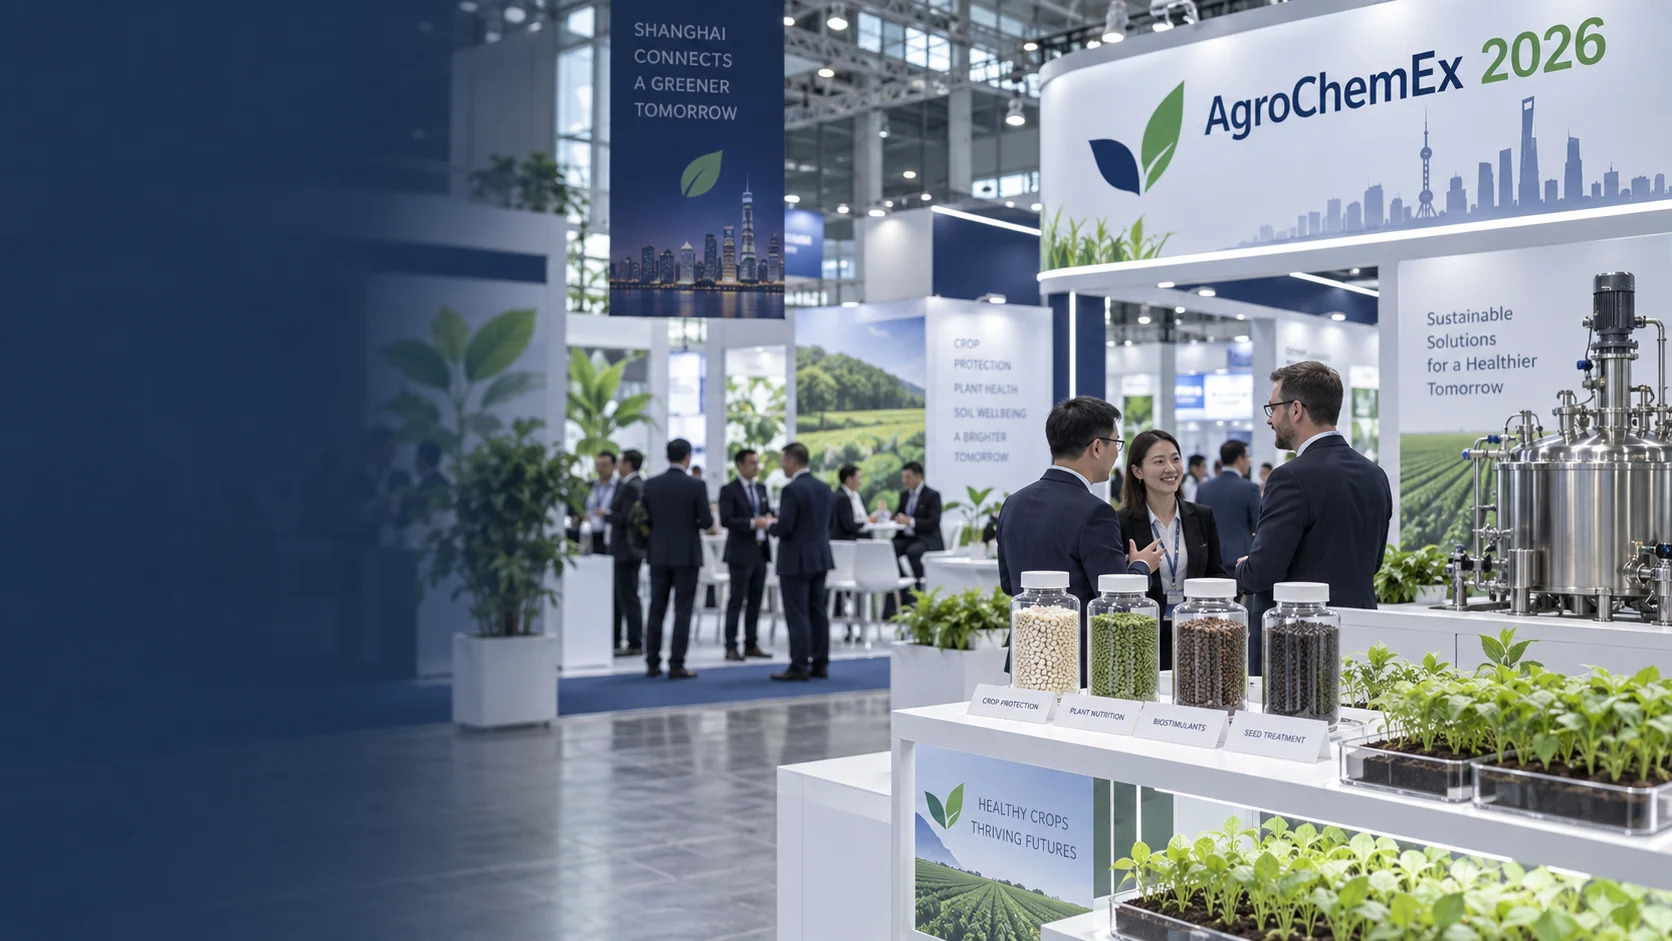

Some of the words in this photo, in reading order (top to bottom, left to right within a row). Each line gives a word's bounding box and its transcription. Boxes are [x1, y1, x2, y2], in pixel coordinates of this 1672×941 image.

[634, 22, 726, 41] SHANGHAI
[634, 48, 733, 68] CONNECTS
[634, 75, 646, 91] A
[651, 76, 730, 94] GREENER
[1204, 50, 1464, 141] AgroChemEx
[1481, 16, 1607, 85] 2026
[634, 102, 738, 121] TOMORROW
[1427, 306, 1513, 326] Sustainable
[954, 338, 980, 349] CROP
[1427, 333, 1497, 350] Solutions
[954, 358, 1012, 371] PROTECTION
[1427, 358, 1448, 373] for
[1453, 361, 1461, 372] a
[1466, 353, 1538, 371] Healthier
[954, 383, 983, 394] PLANT
[985, 384, 1018, 395] HEALTH
[1427, 381, 1504, 396] Tomorrow
[954, 407, 975, 418] SOIL
[977, 408, 1027, 419] WELLBEING
[954, 432, 960, 442] A
[963, 432, 1007, 443] BRIGHTER
[954, 451, 1009, 462] TOMORROW
[982, 697, 1000, 706] CROP
[1000, 699, 1040, 710] PROTECTION
[1069, 707, 1090, 717] PLANT
[1090, 710, 1125, 721] NUTRITION
[1152, 717, 1207, 732] BIOSTIMULANTS
[1244, 728, 1262, 738] SEED
[1264, 731, 1306, 744] TREATMENT
[978, 797, 1028, 820] HEALTHY
[1030, 809, 1069, 831] CROPS
[971, 820, 1022, 846] THRIVING
[1025, 834, 1077, 860] FUTURES
